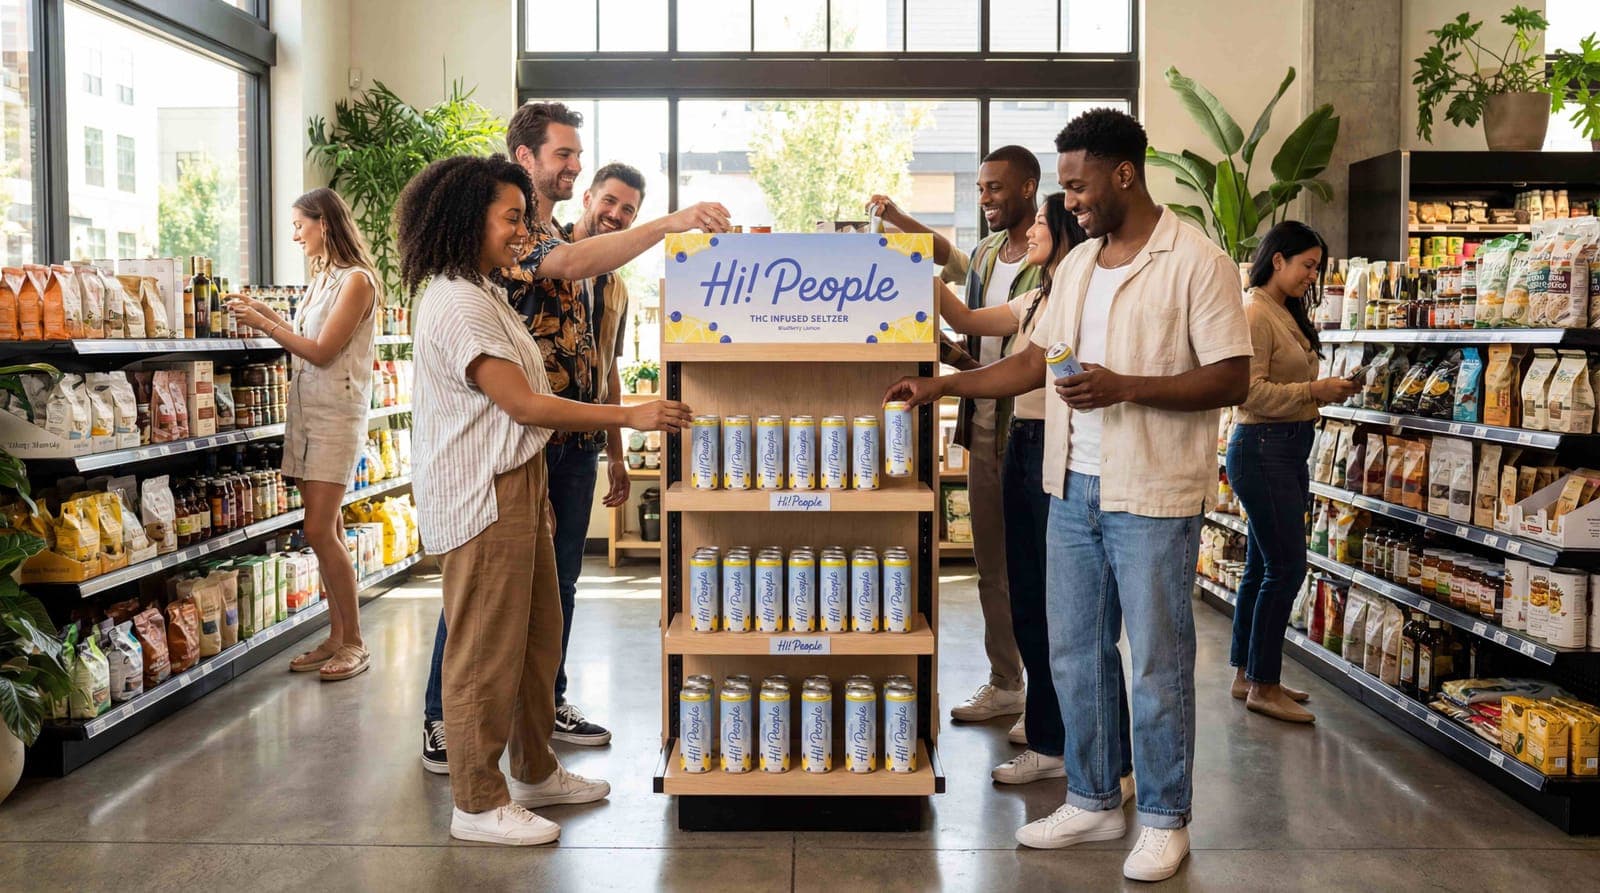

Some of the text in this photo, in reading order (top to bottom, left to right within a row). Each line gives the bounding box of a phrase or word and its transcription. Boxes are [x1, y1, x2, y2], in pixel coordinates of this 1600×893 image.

[700, 257, 899, 312] Hi! People
[750, 314, 849, 323] THC INFUSED SELTZER
